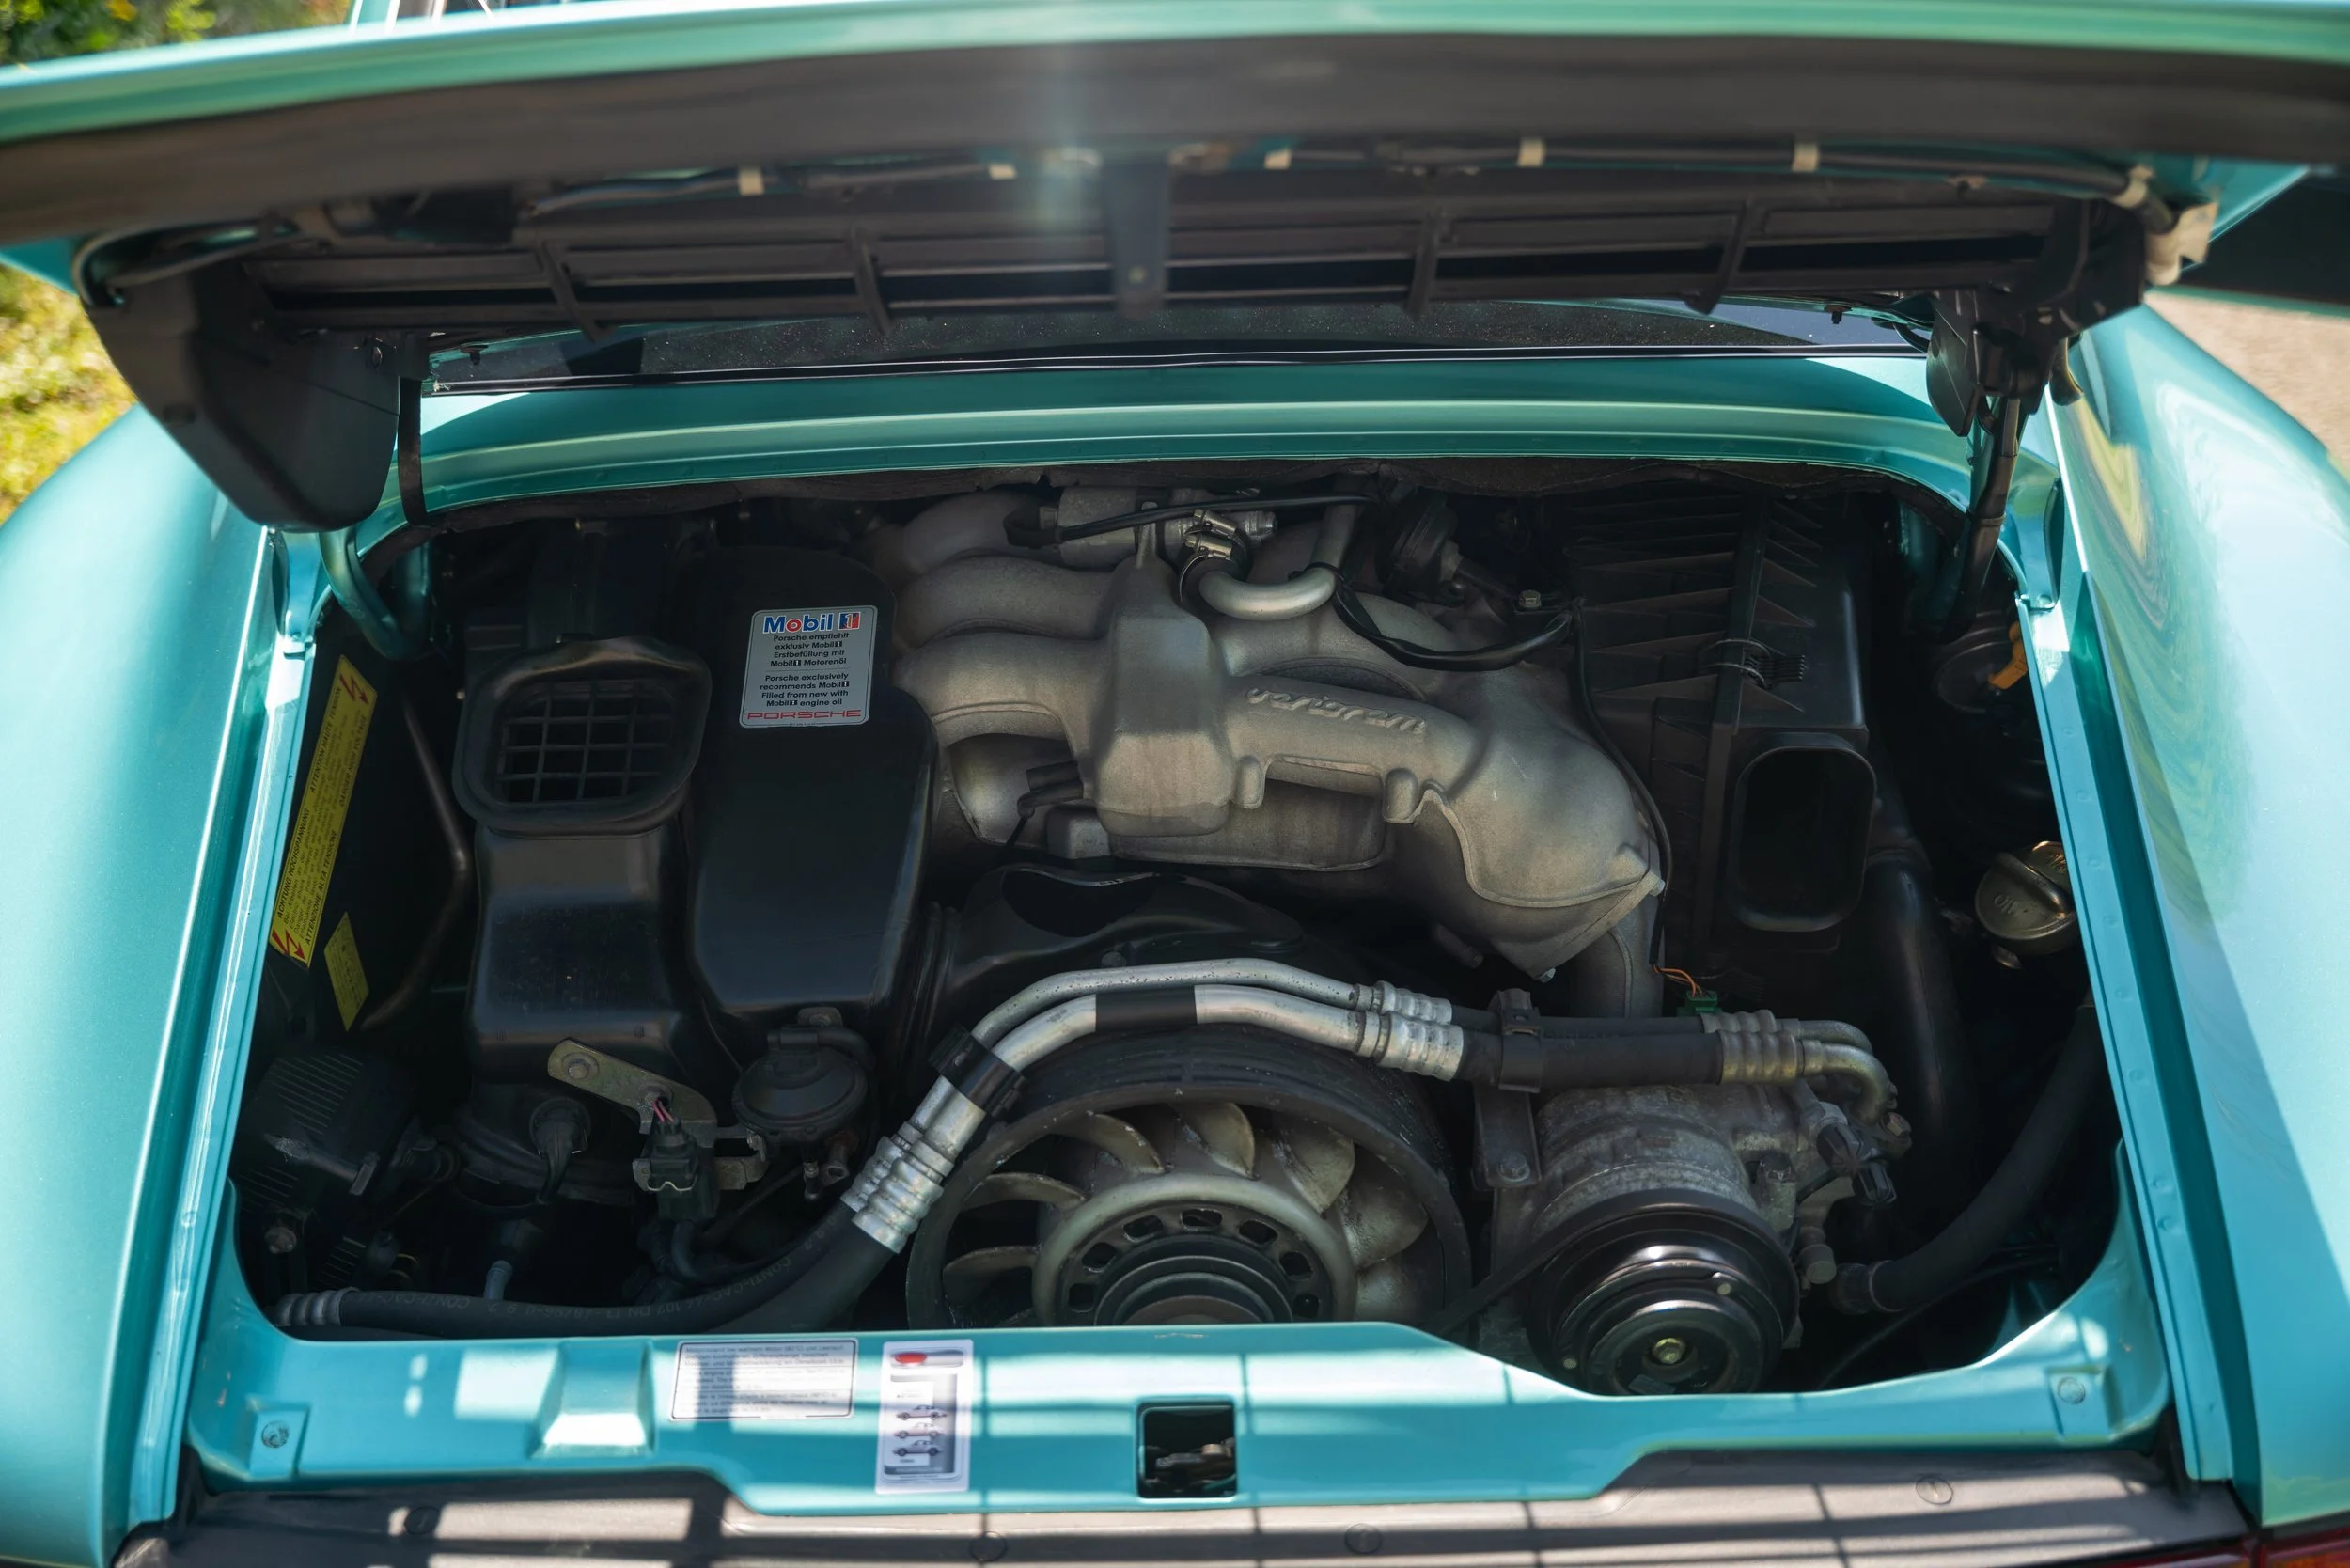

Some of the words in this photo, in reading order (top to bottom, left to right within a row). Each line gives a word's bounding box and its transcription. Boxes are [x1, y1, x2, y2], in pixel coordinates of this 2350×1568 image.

[763, 613, 834, 634] Mobil
[809, 632, 849, 641] empfiehlt
[801, 673, 849, 682] exclusively
[800, 699, 830, 708] engine
[747, 710, 862, 720] PORSCHE
[310, 747, 325, 792] ATTENTION
[277, 877, 291, 917] ACHTUNG
[289, 808, 310, 875] HOCHSPANNUNG
[305, 894, 322, 944] ATTENZIONE
[319, 870, 327, 891] ALTA
[324, 829, 337, 867] TENSIONE
